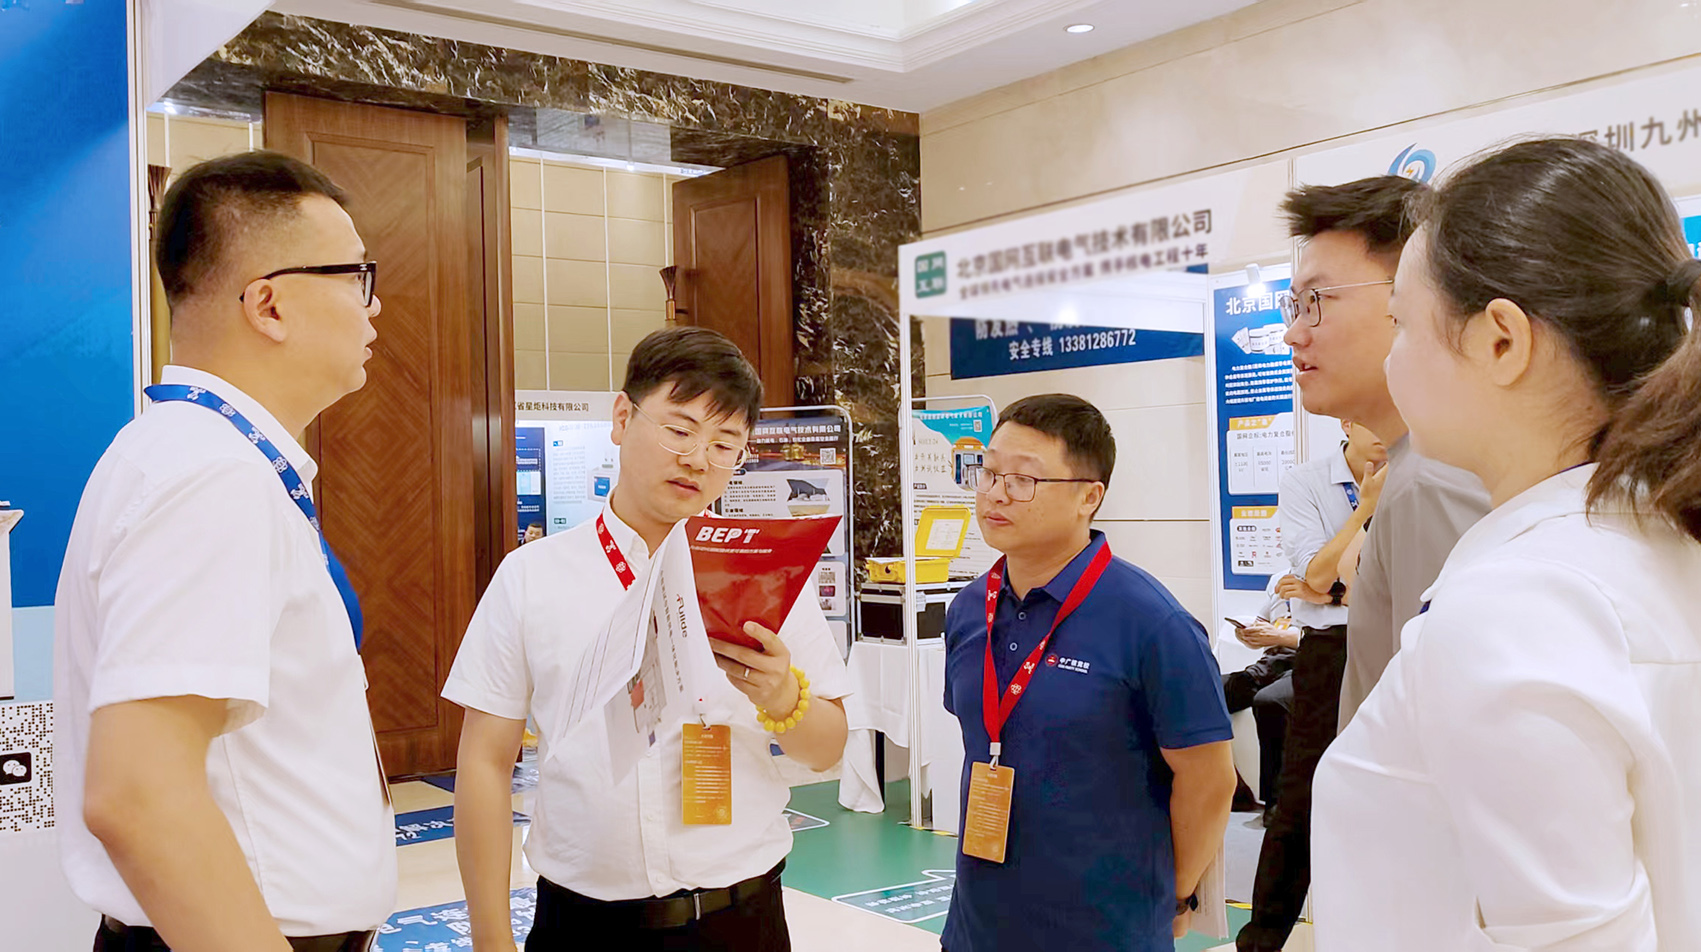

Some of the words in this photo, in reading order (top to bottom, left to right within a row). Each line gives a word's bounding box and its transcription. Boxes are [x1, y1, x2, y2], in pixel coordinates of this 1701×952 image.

[1008, 336, 1054, 360] 安全专线
[1059, 329, 1136, 353] 13381286772
[515, 402, 589, 411] 省星炬科技有限公司
[695, 526, 761, 544] BEPT
